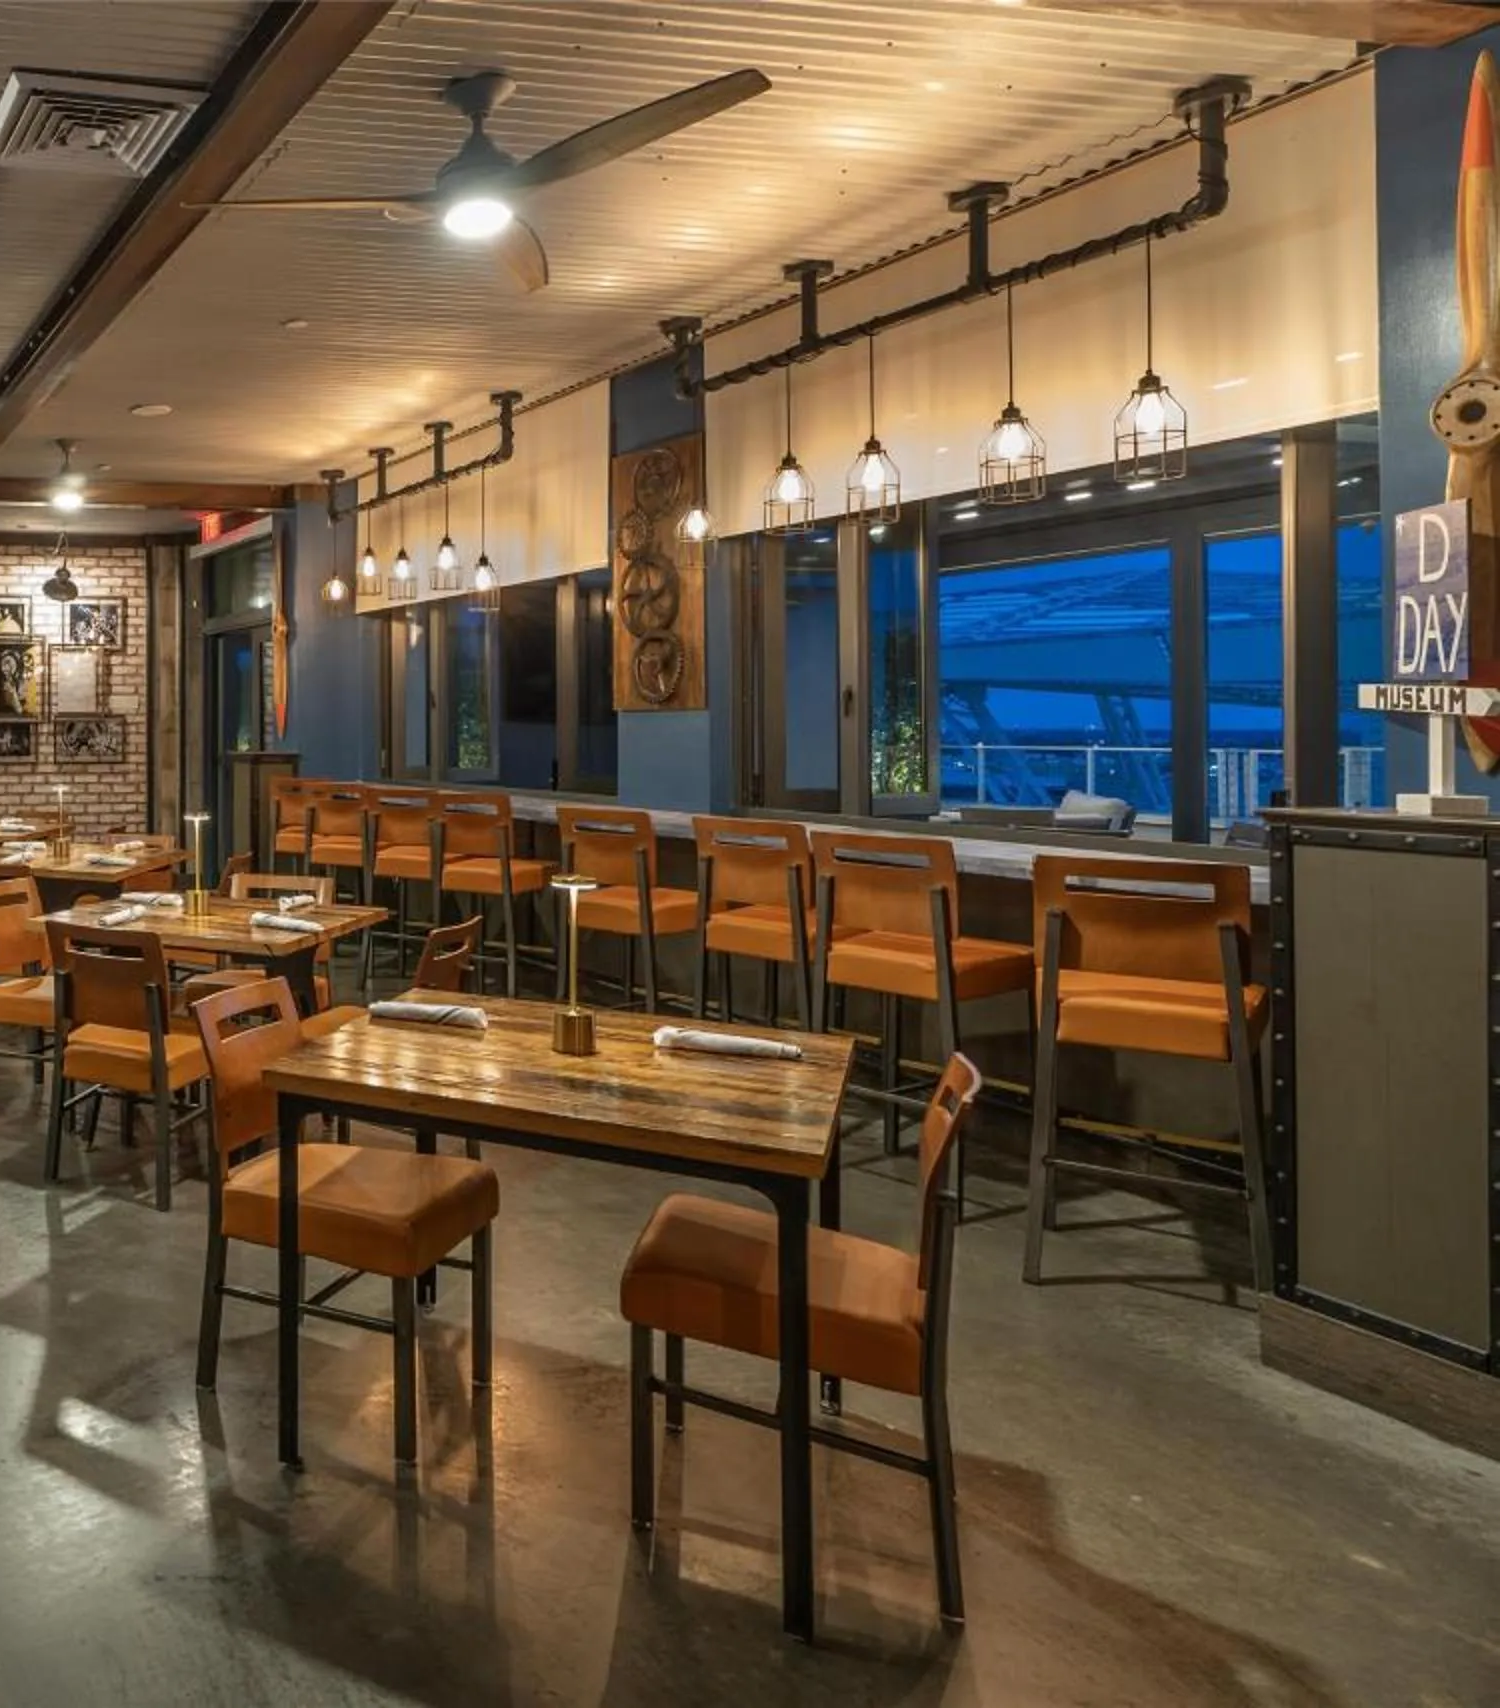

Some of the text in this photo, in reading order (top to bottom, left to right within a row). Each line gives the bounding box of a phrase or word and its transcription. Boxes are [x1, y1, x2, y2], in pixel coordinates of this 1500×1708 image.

[1420, 513, 1449, 582] D
[1399, 592, 1468, 674] DAY
[1375, 686, 1467, 713] MUSEUM
